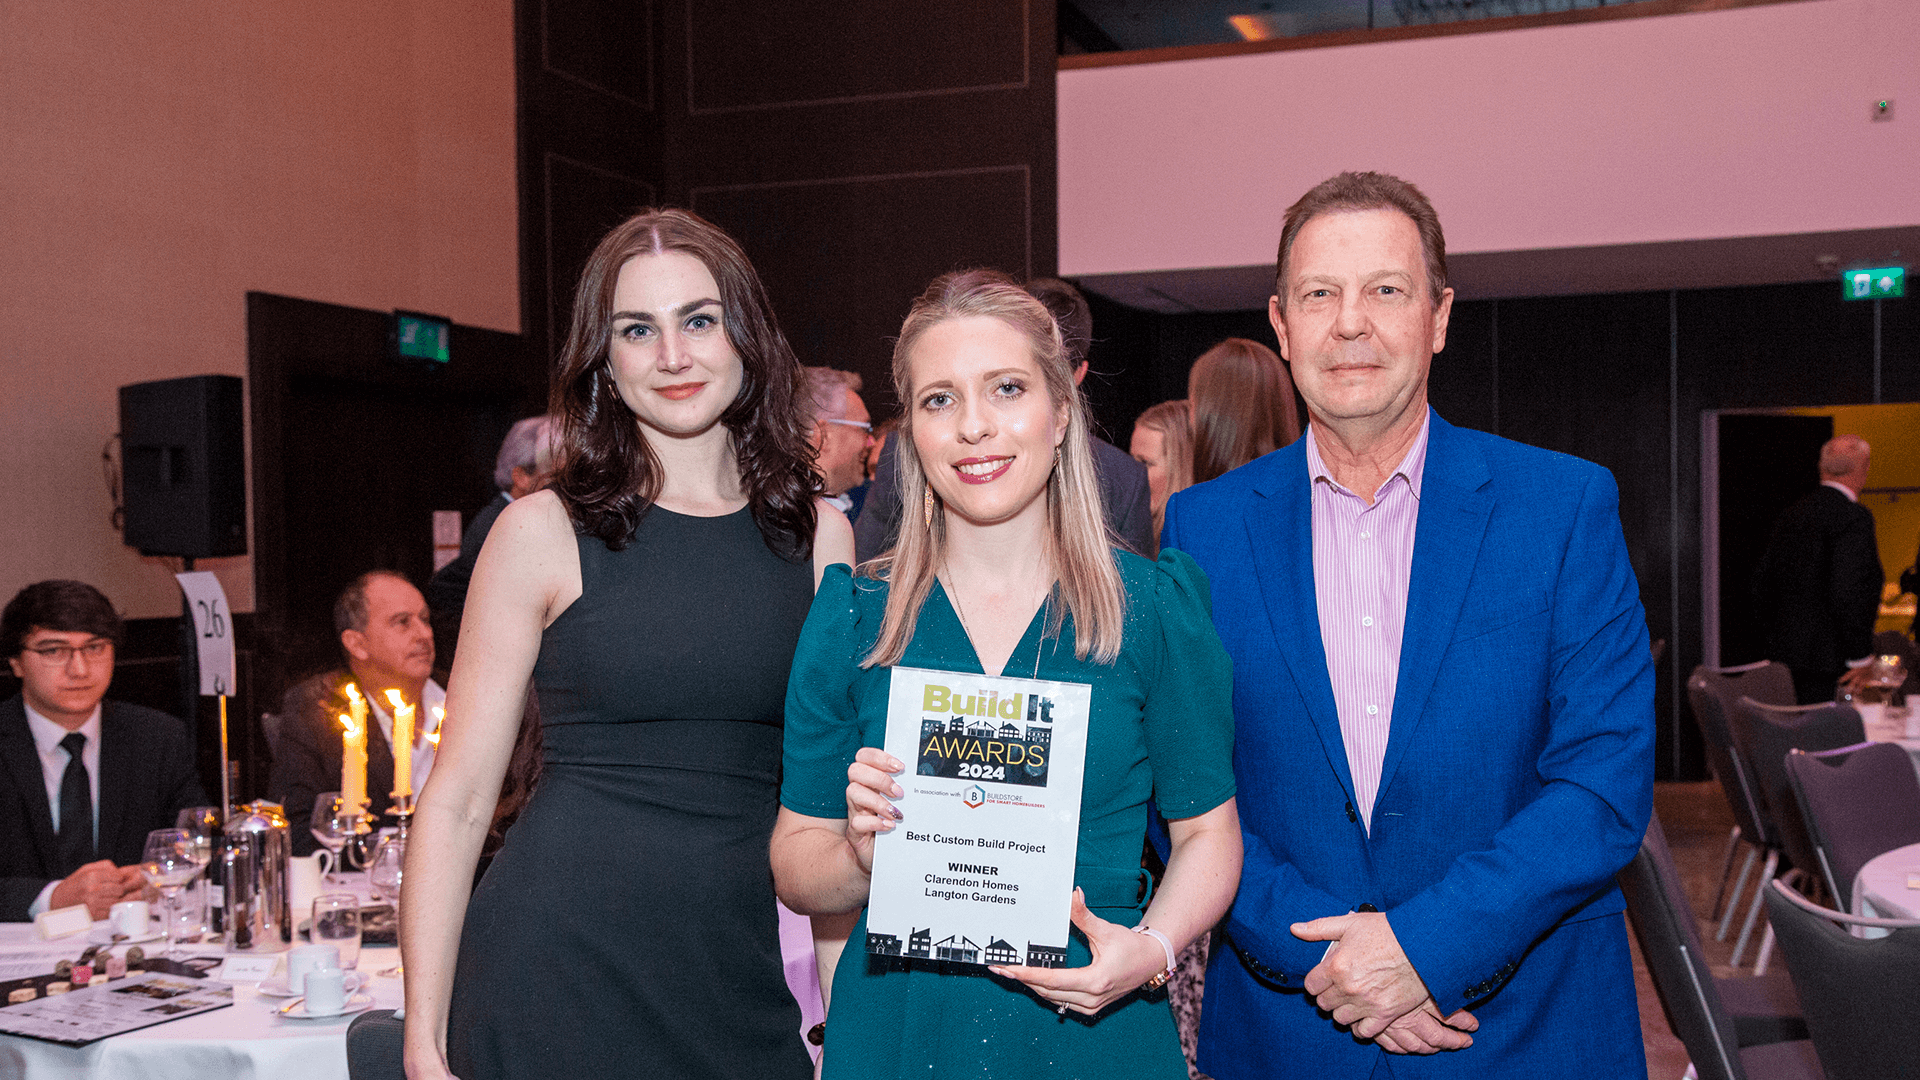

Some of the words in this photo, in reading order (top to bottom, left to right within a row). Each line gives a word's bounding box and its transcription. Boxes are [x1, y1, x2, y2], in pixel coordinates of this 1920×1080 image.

[197, 599, 225, 638] 26
[922, 683, 1024, 720] Build
[1026, 693, 1055, 724] It
[923, 735, 1045, 767] AWARDS
[957, 762, 1006, 780] 2024
[920, 788, 949, 797] association
[950, 790, 961, 798] with
[971, 792, 978, 801] B
[986, 792, 1023, 802] BUILDSTORE
[1012, 801, 1046, 809] HOMEBUILDERS
[906, 831, 931, 842] Best
[933, 834, 974, 847] Custom
[977, 838, 1005, 850] Build
[1008, 841, 1046, 854] Project
[948, 862, 999, 876] WINNER
[924, 873, 979, 888] Clarendon
[982, 880, 1019, 892] Homes
[924, 887, 969, 901] Langton
[971, 892, 1017, 905] Gardens
